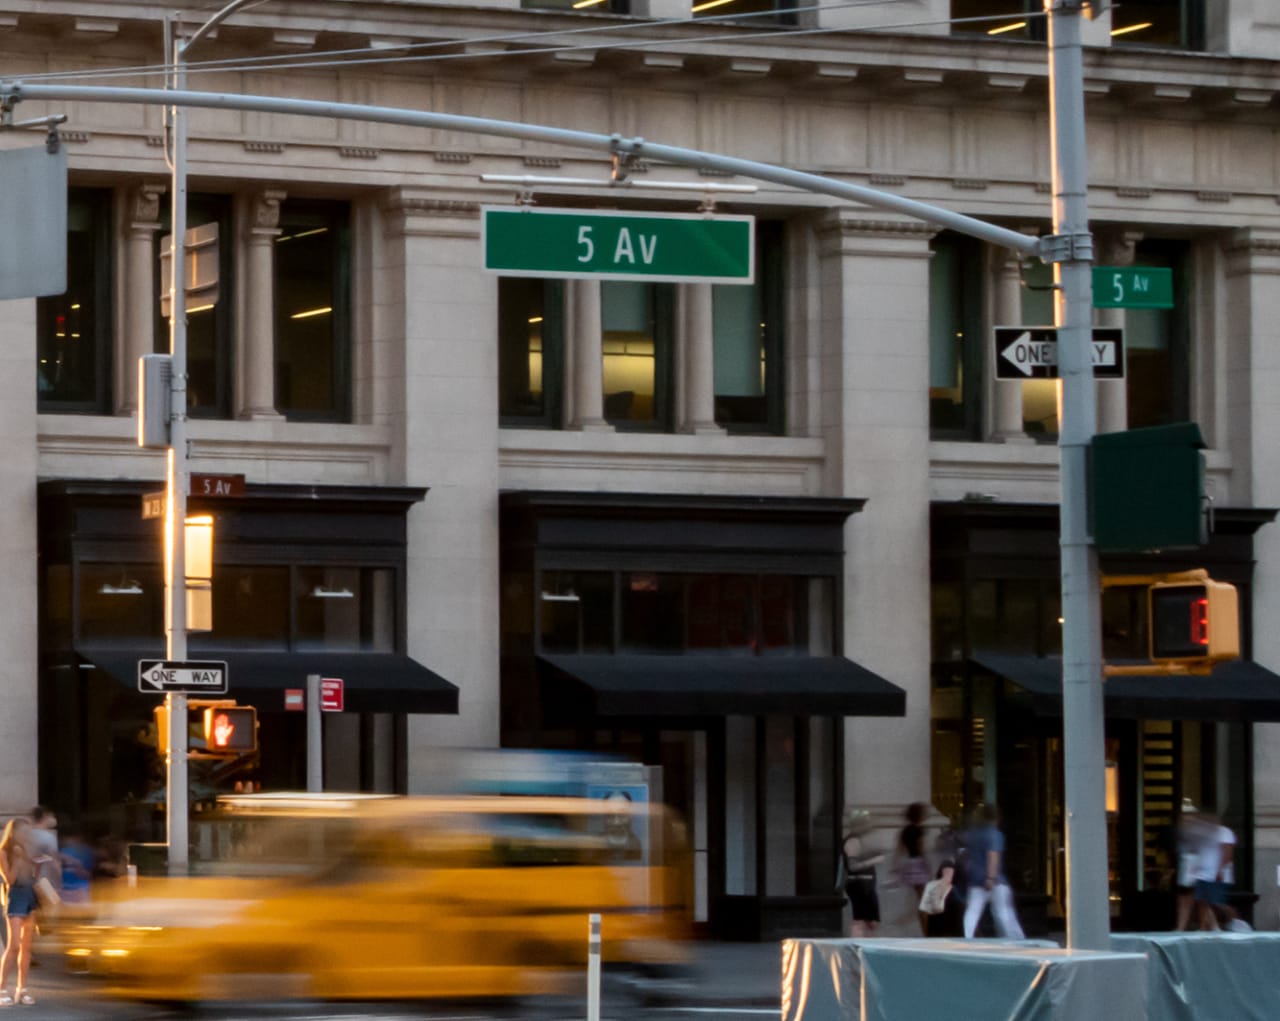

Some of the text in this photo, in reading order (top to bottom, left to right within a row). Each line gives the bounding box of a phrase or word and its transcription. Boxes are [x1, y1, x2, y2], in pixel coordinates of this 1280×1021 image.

[577, 226, 657, 265] 5 Av
[1113, 273, 1148, 302] 5 Av
[1015, 344, 1050, 363] ONE
[204, 479, 231, 495] 5 Av
[151, 670, 218, 683] ONE WAY
